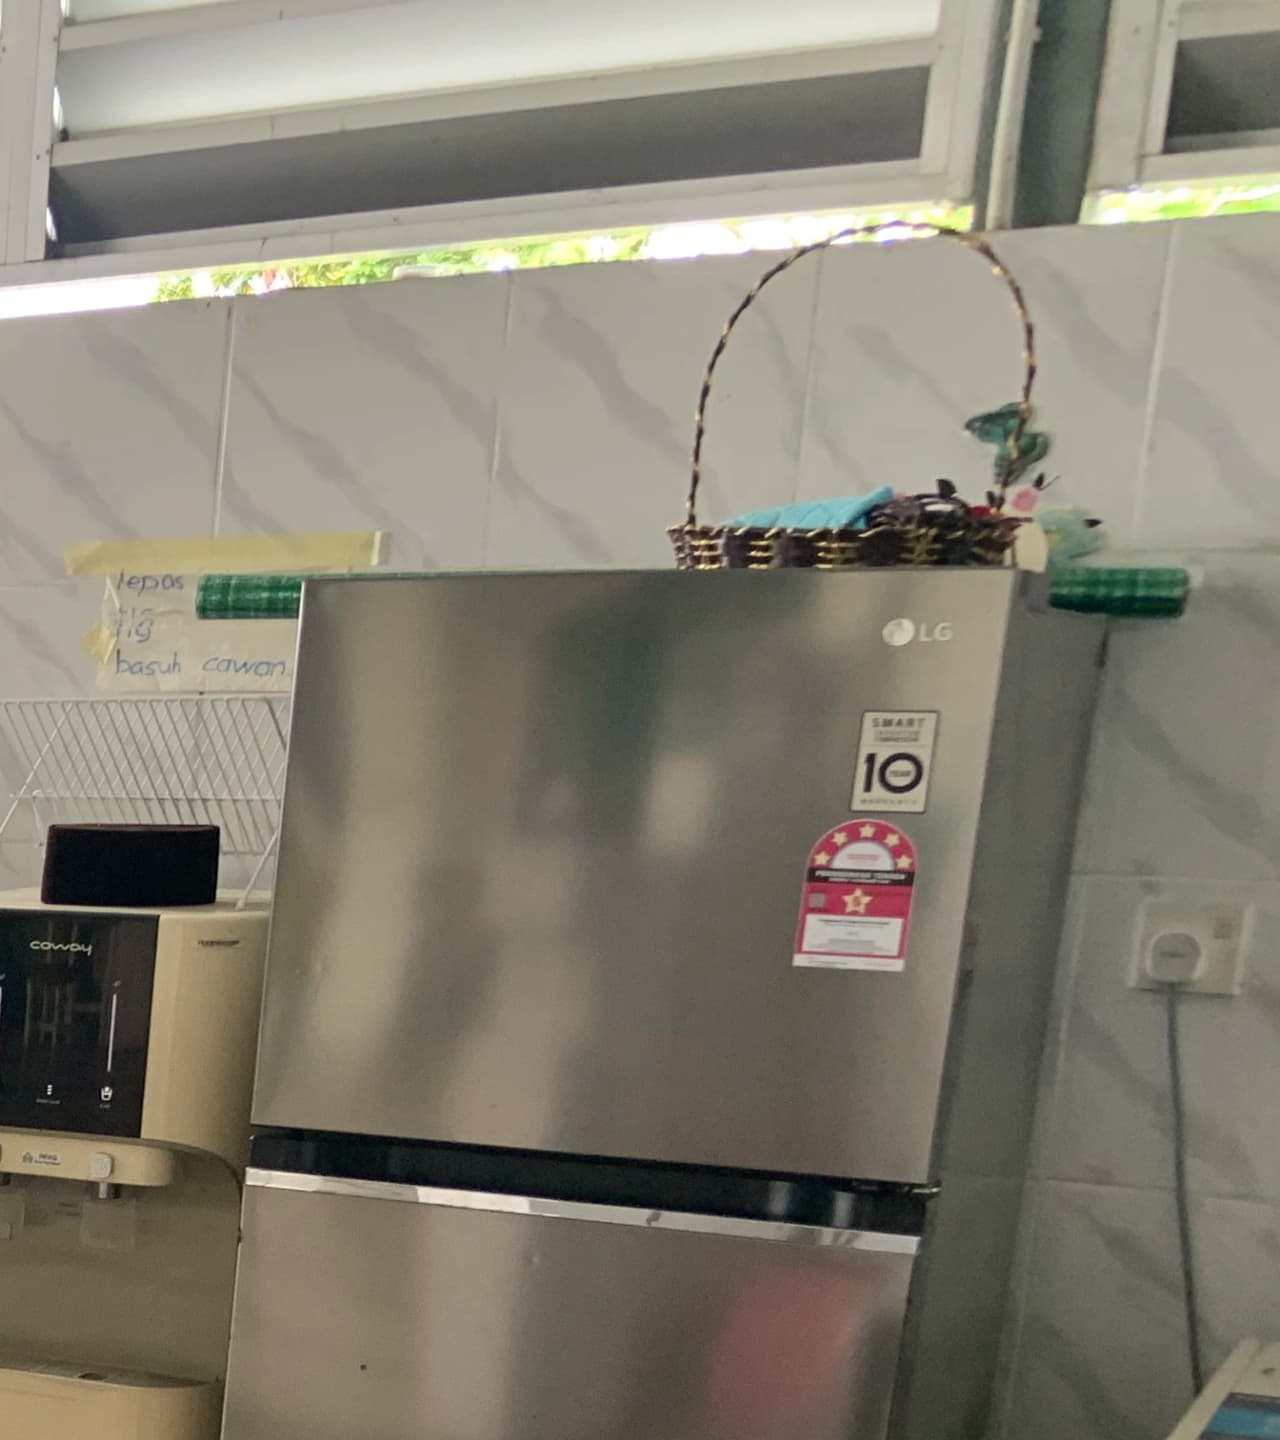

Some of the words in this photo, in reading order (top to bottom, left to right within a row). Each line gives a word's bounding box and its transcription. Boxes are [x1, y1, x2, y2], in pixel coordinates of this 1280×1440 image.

[919, 622, 953, 641] LG
[115, 648, 182, 676] basuh
[863, 752, 924, 794] 10
